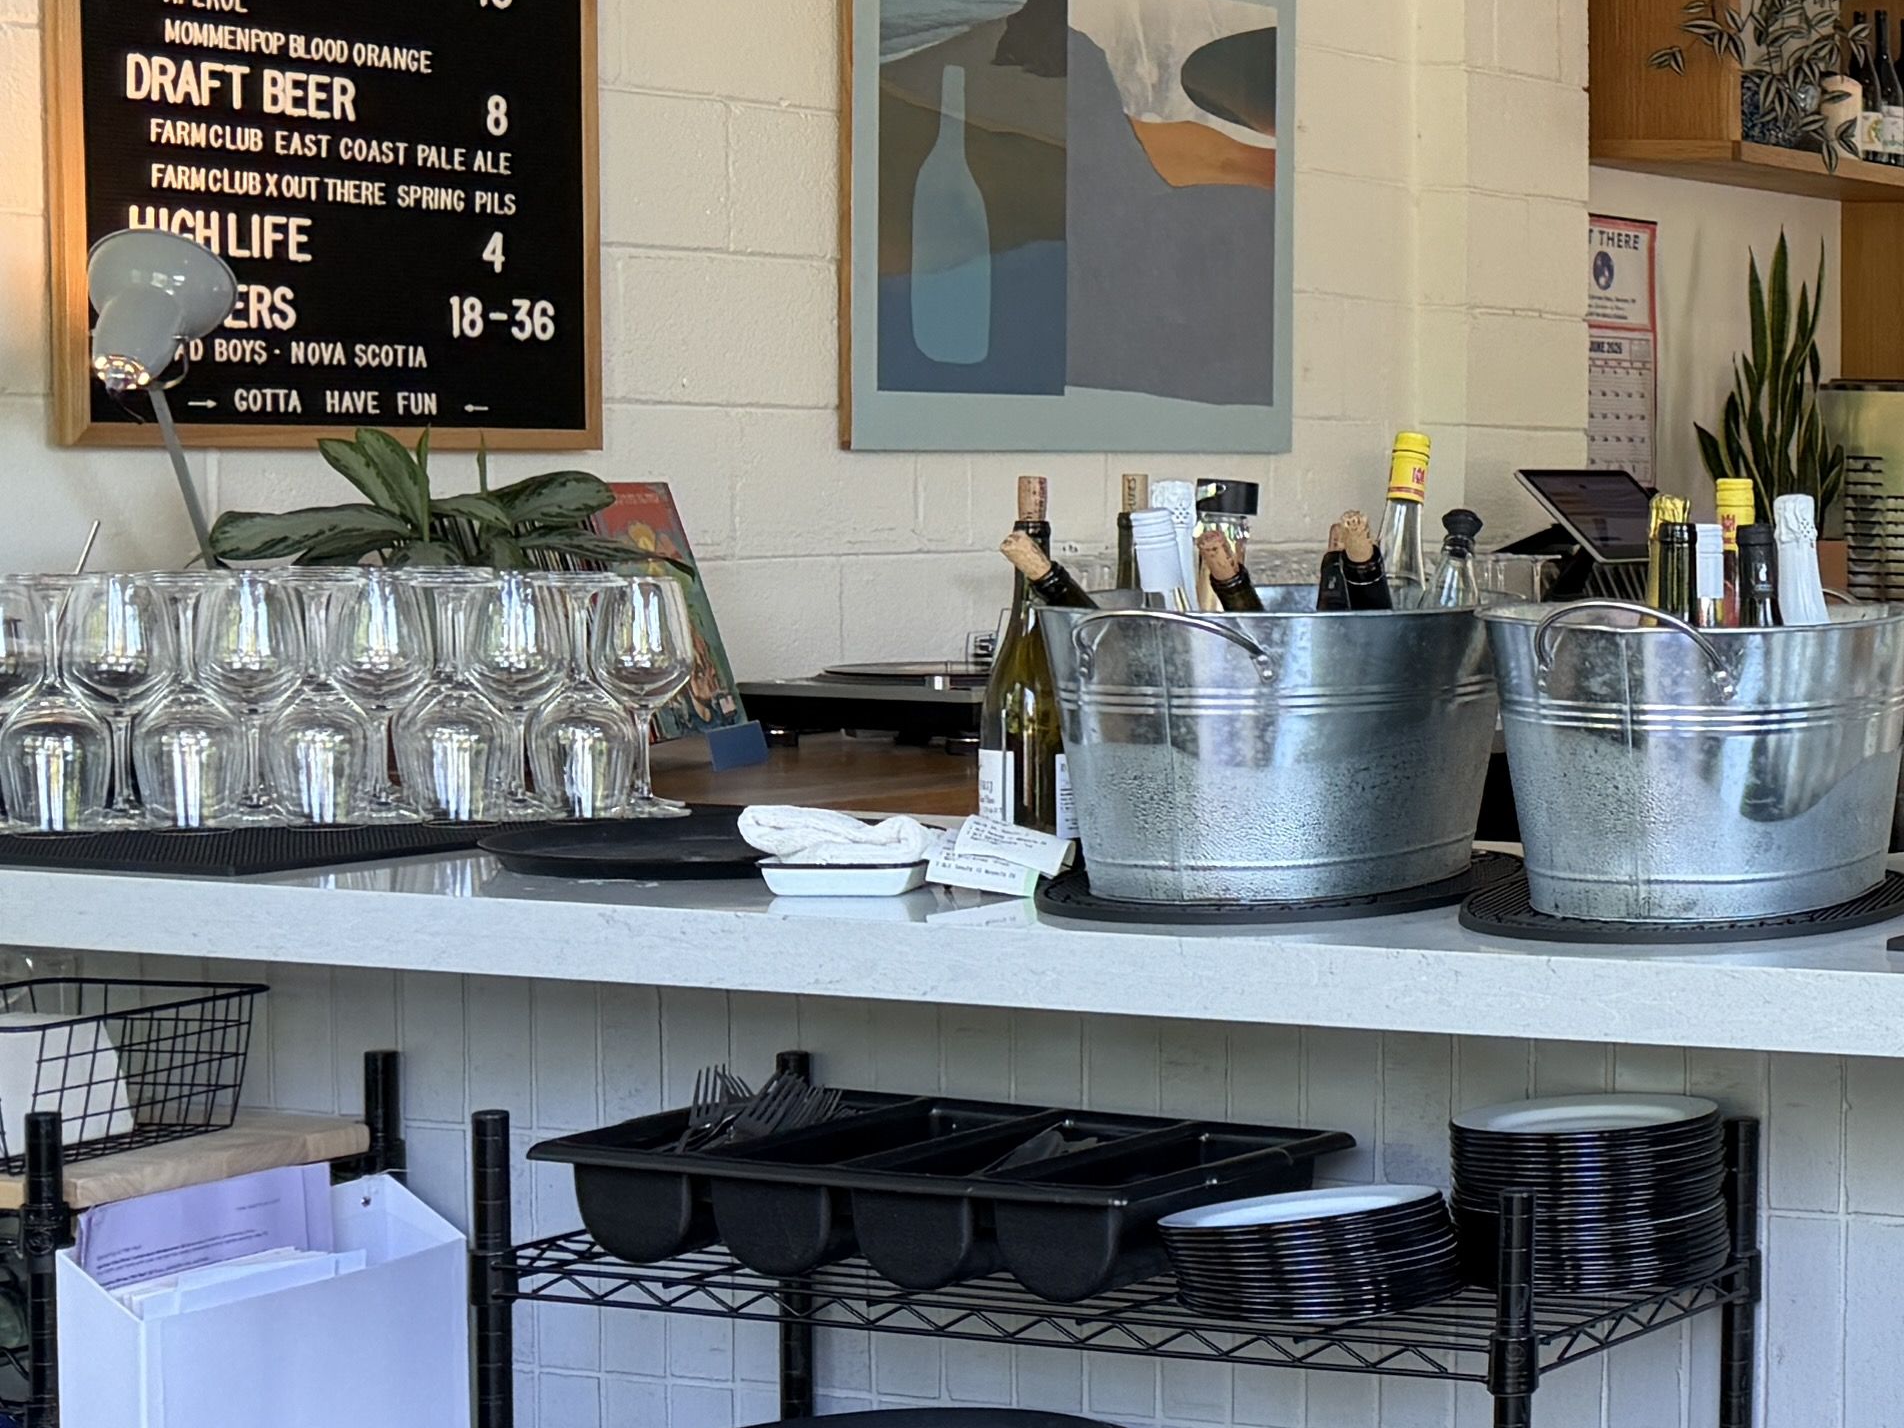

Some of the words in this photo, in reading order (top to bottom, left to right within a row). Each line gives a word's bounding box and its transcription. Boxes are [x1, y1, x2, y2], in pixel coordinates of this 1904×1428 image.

[164, 18, 286, 56] MOMMENPOP
[288, 33, 348, 64] BLOOD
[352, 42, 433, 74] ORANGE
[126, 52, 250, 110] DRAFT
[262, 68, 356, 122] BEER
[486, 94, 508, 137] 8
[275, 130, 332, 158] EAST
[339, 137, 409, 166] COAST
[417, 144, 466, 171] PALE
[473, 149, 512, 175] ALE
[265, 172, 279, 197] X
[281, 174, 320, 202] OUT
[323, 177, 387, 206] THERE
[397, 184, 465, 212] SPRING
[474, 191, 517, 216] PILS
[227, 212, 313, 263] LIFE
[482, 231, 506, 274] 4
[1598, 229, 1640, 251] THERE
[449, 295, 556, 341] 18-36
[214, 338, 267, 364] BOYS
[290, 341, 347, 365] NOVA
[354, 344, 428, 369] SCOTIA
[234, 388, 302, 413] GOTTA
[325, 390, 380, 414] HAVE
[397, 392, 437, 415] FUN
